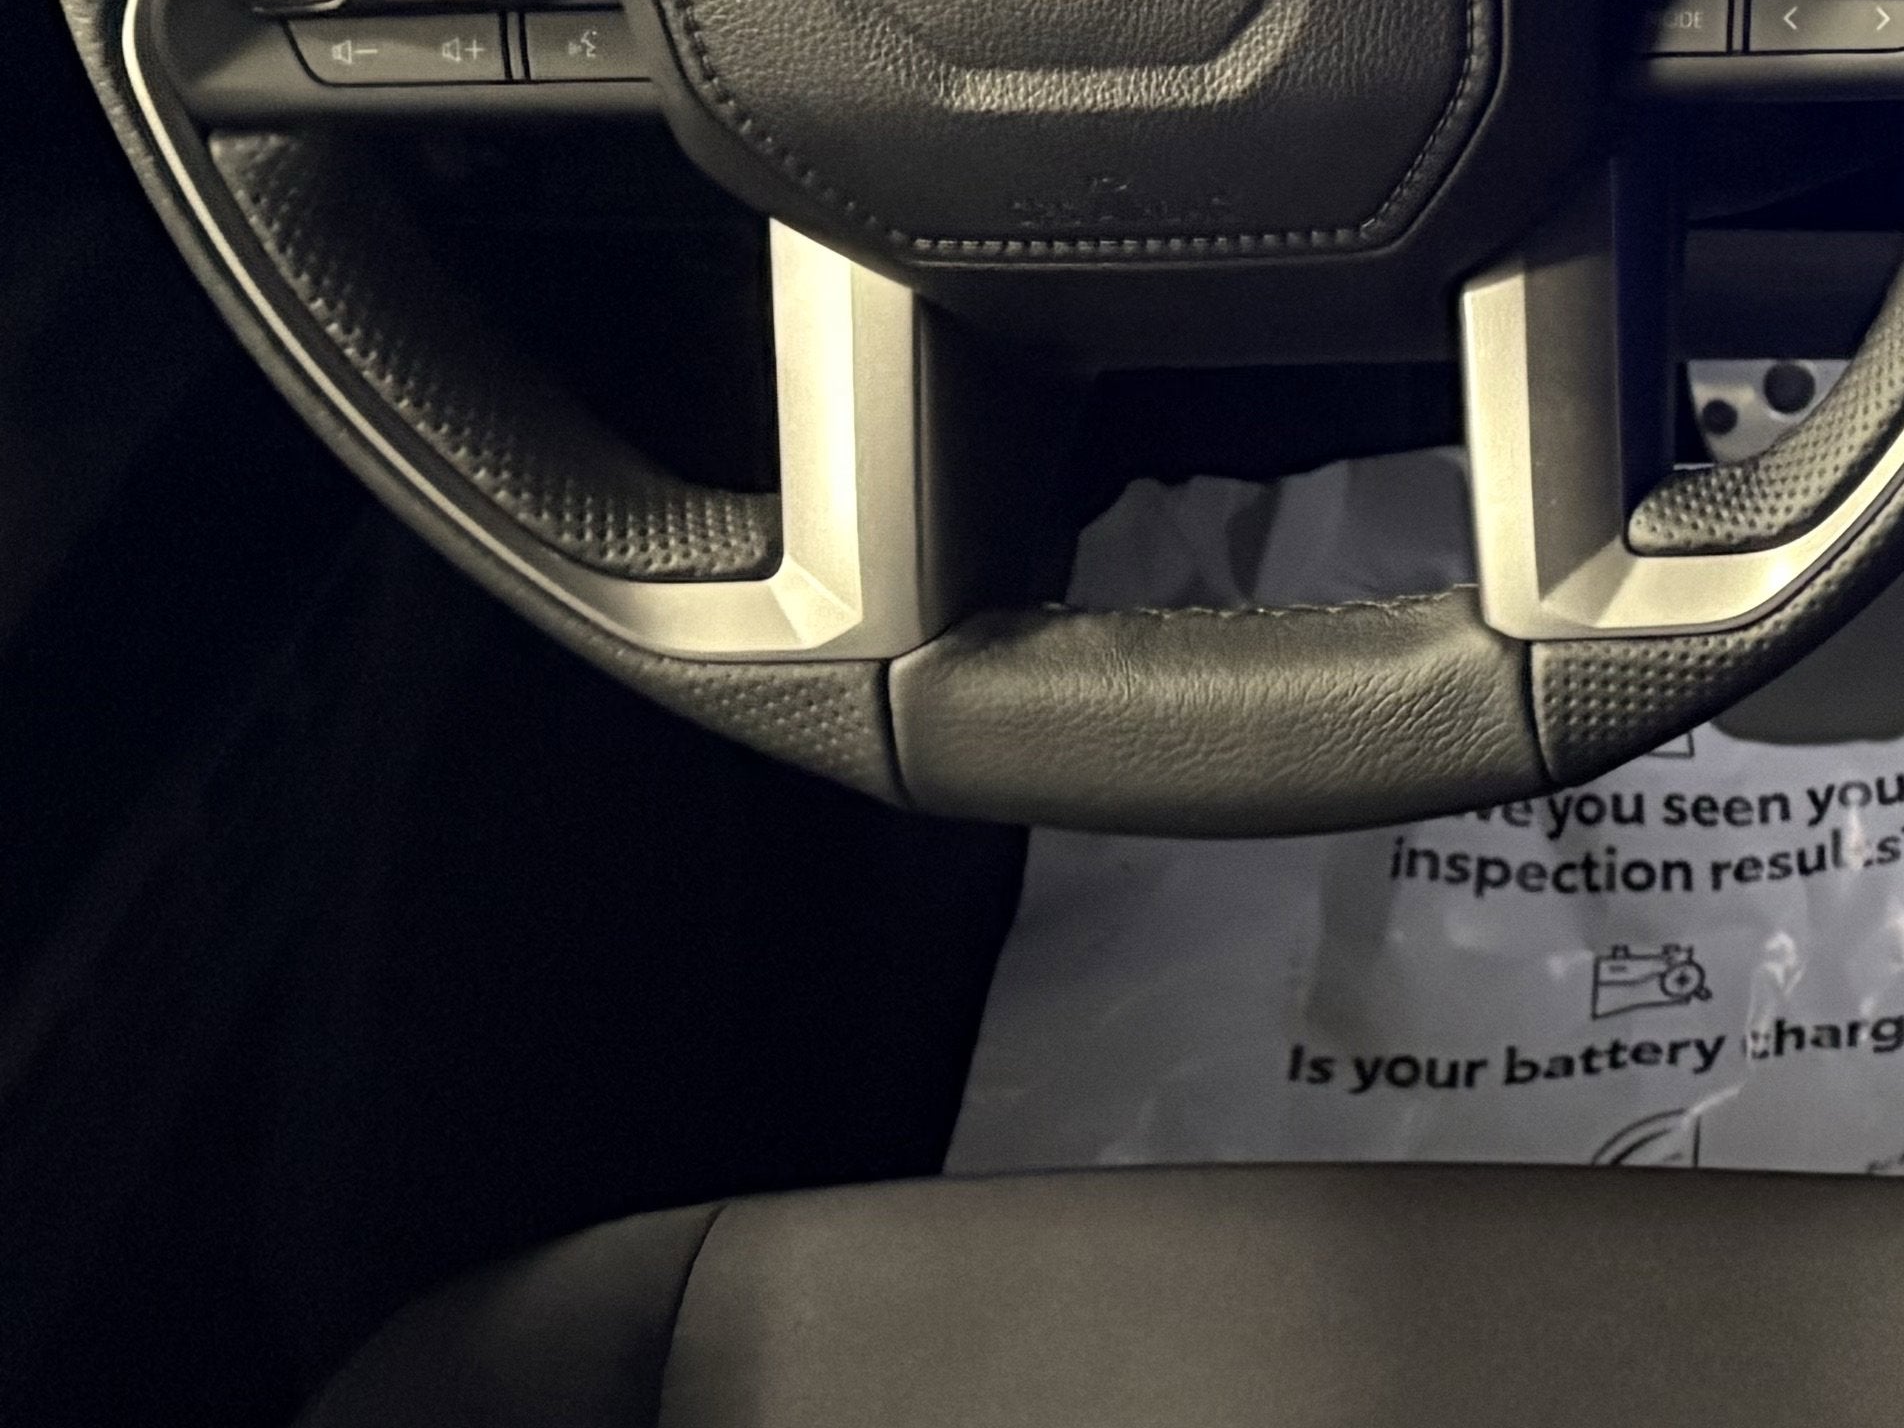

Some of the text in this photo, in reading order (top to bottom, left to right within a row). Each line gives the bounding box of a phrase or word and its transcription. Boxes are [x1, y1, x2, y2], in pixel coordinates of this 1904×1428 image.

[1545, 791, 1645, 840] you
[1662, 791, 1791, 827] seen
[1391, 836, 1694, 898] inspection
[1288, 1044, 1334, 1086] Is
[1349, 1054, 1488, 1094] your
[1504, 1030, 1726, 1087] battery
